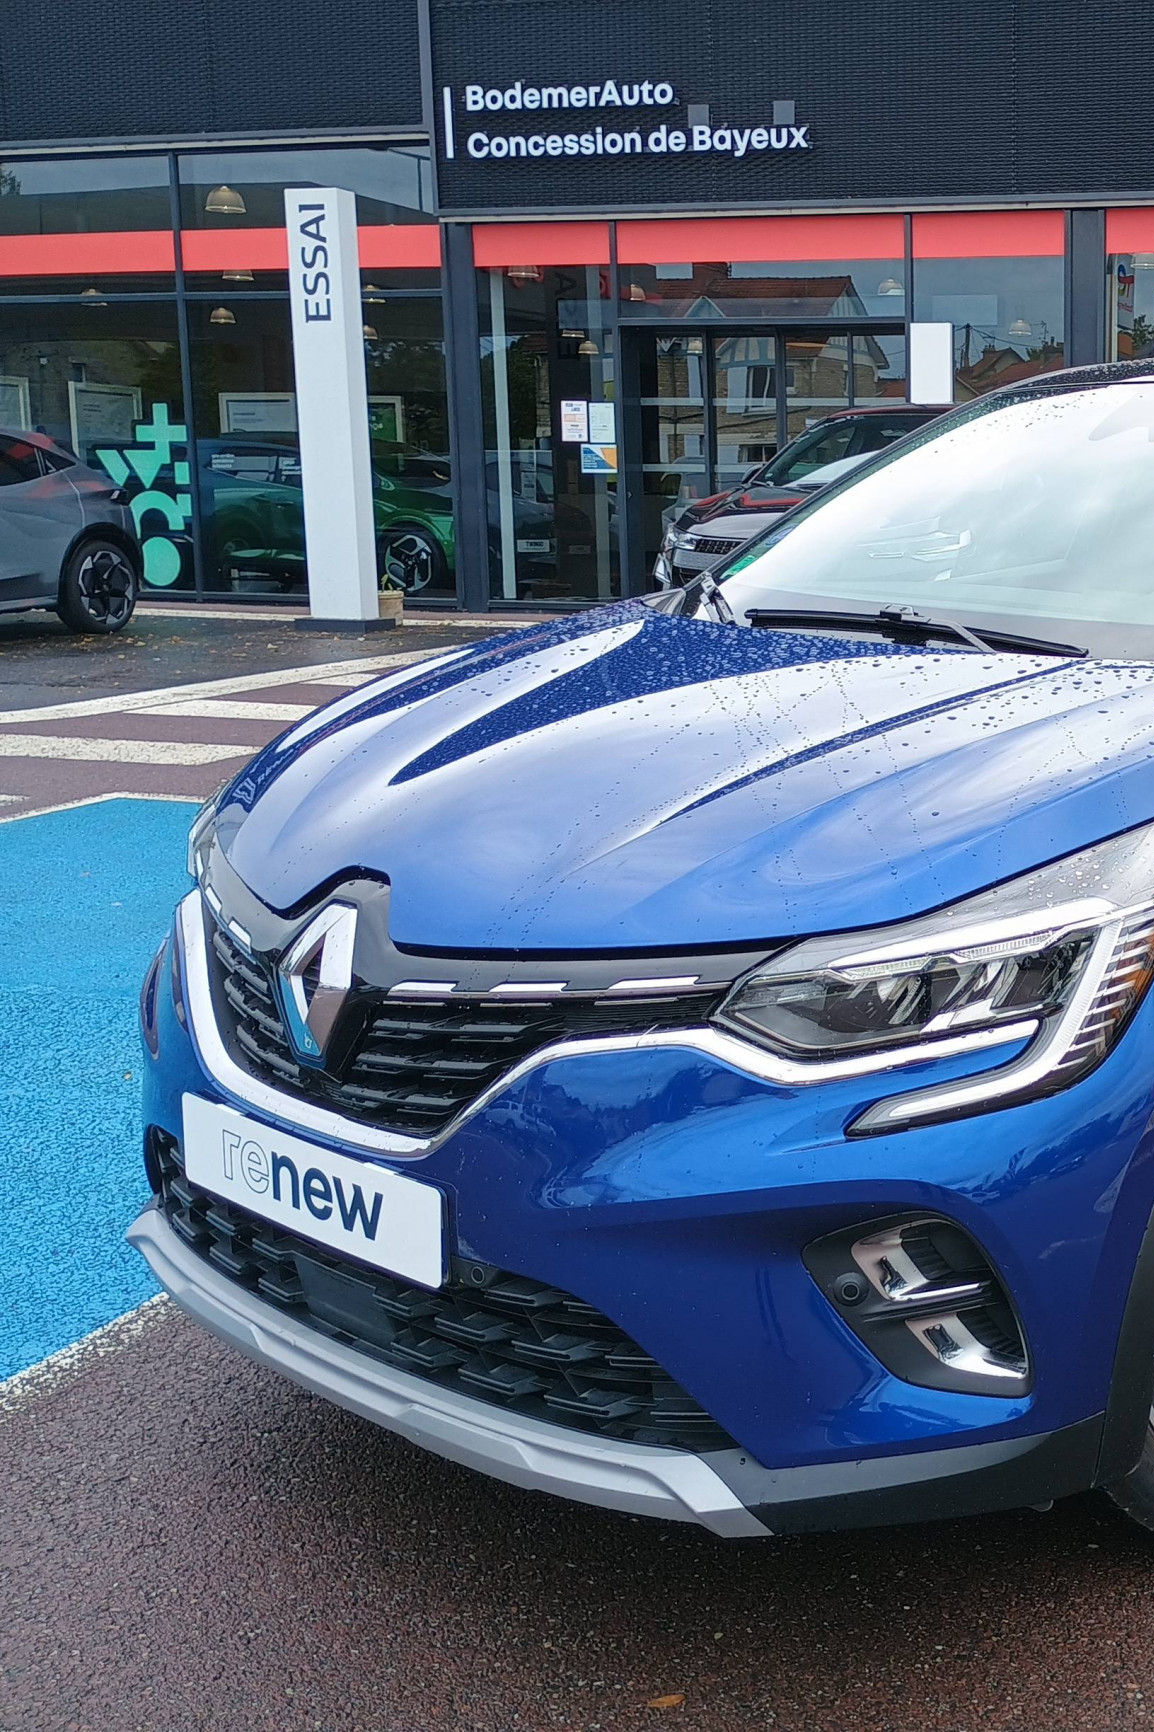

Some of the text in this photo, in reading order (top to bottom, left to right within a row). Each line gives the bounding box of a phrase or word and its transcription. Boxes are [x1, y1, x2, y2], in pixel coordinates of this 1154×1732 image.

[465, 79, 674, 111] BodemerAuto
[466, 124, 810, 158] Concession de Bayeux
[298, 203, 332, 323] ESSAI
[222, 1128, 384, 1241] renew
